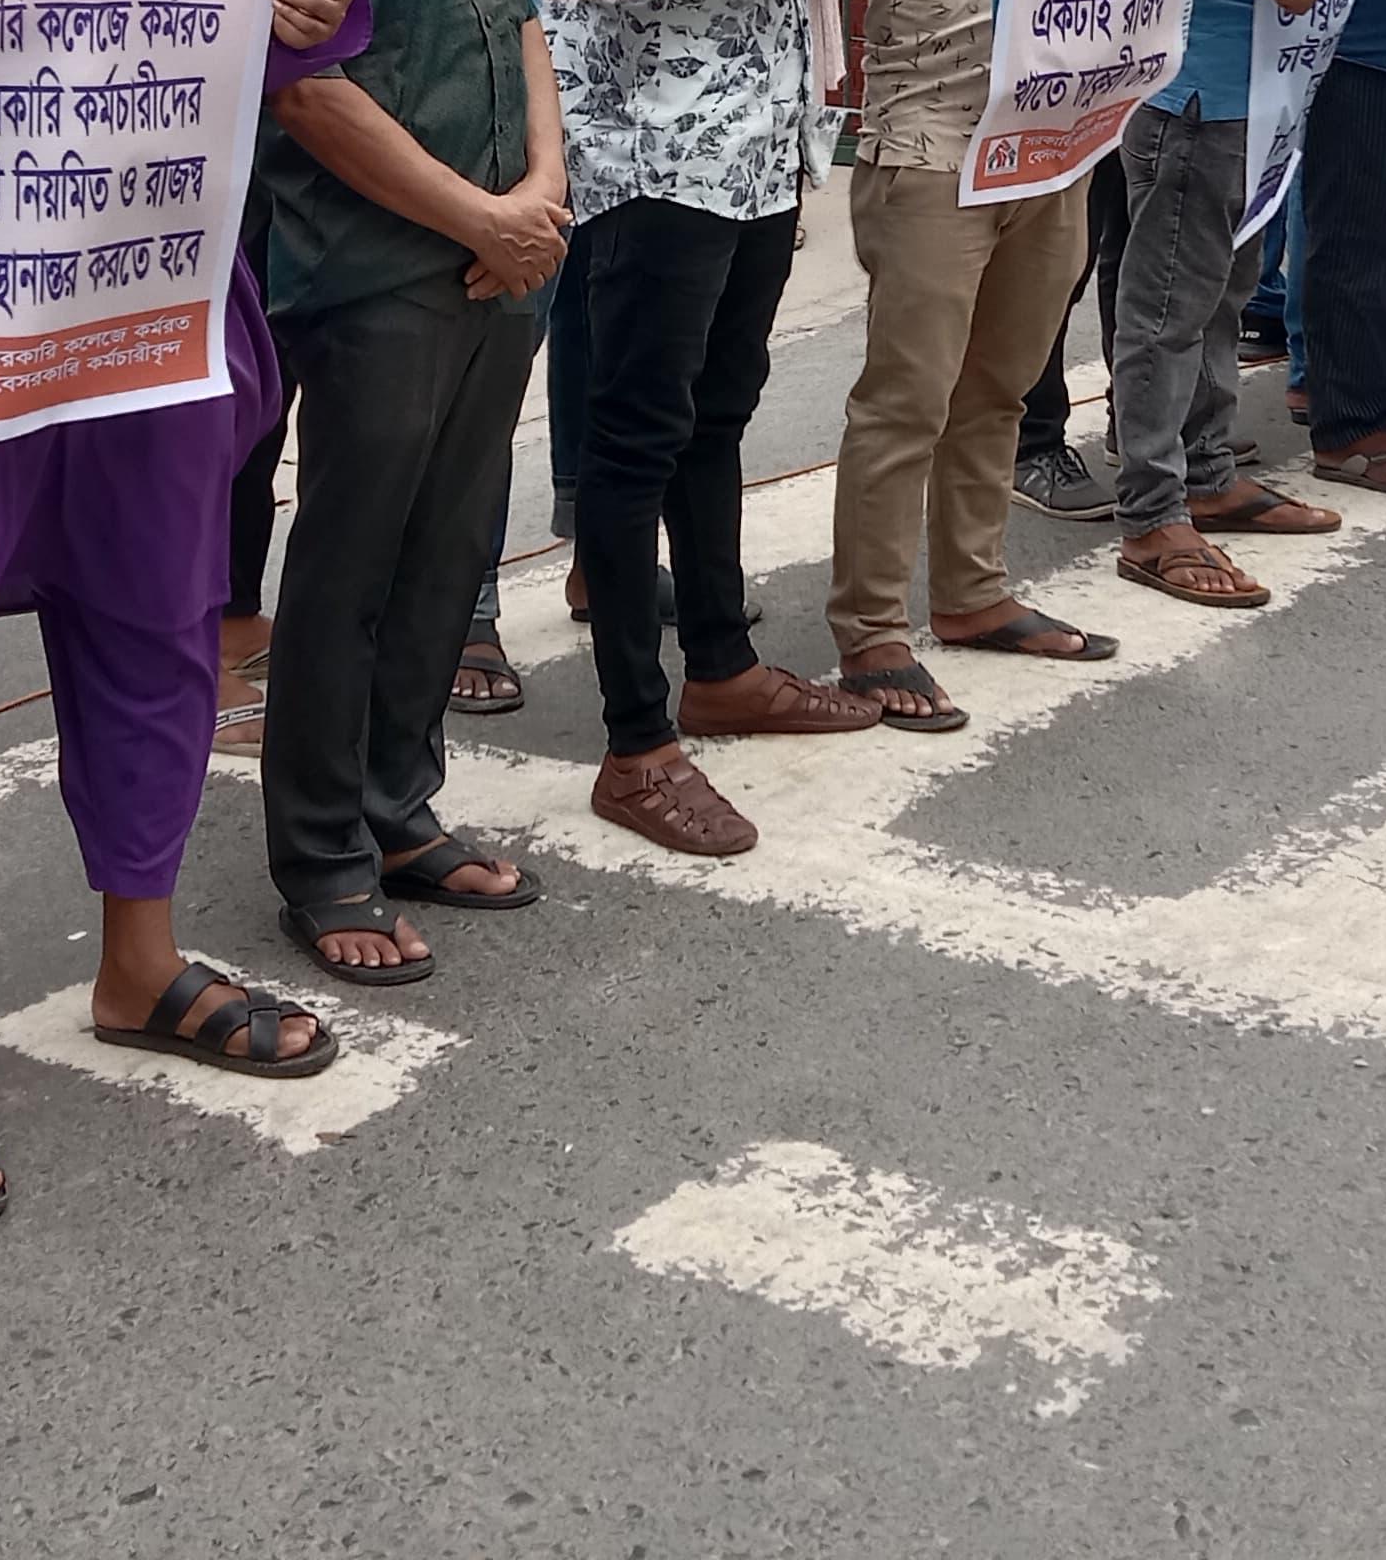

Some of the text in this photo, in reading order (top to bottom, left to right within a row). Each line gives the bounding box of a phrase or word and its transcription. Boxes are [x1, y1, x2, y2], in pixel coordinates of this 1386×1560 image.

[34, 0, 133, 54] কলেজে
[72, 59, 206, 137] কর্মচারীদের
[1015, 69, 1073, 112] খাতে
[11, 149, 113, 223] নিয়মিত
[120, 166, 138, 208] ও
[145, 153, 207, 208] রাজস্ব
[86, 237, 154, 292] করতে
[159, 229, 206, 280] হবে
[63, 325, 129, 353] কলেজে
[133, 314, 193, 338] কর্মরত
